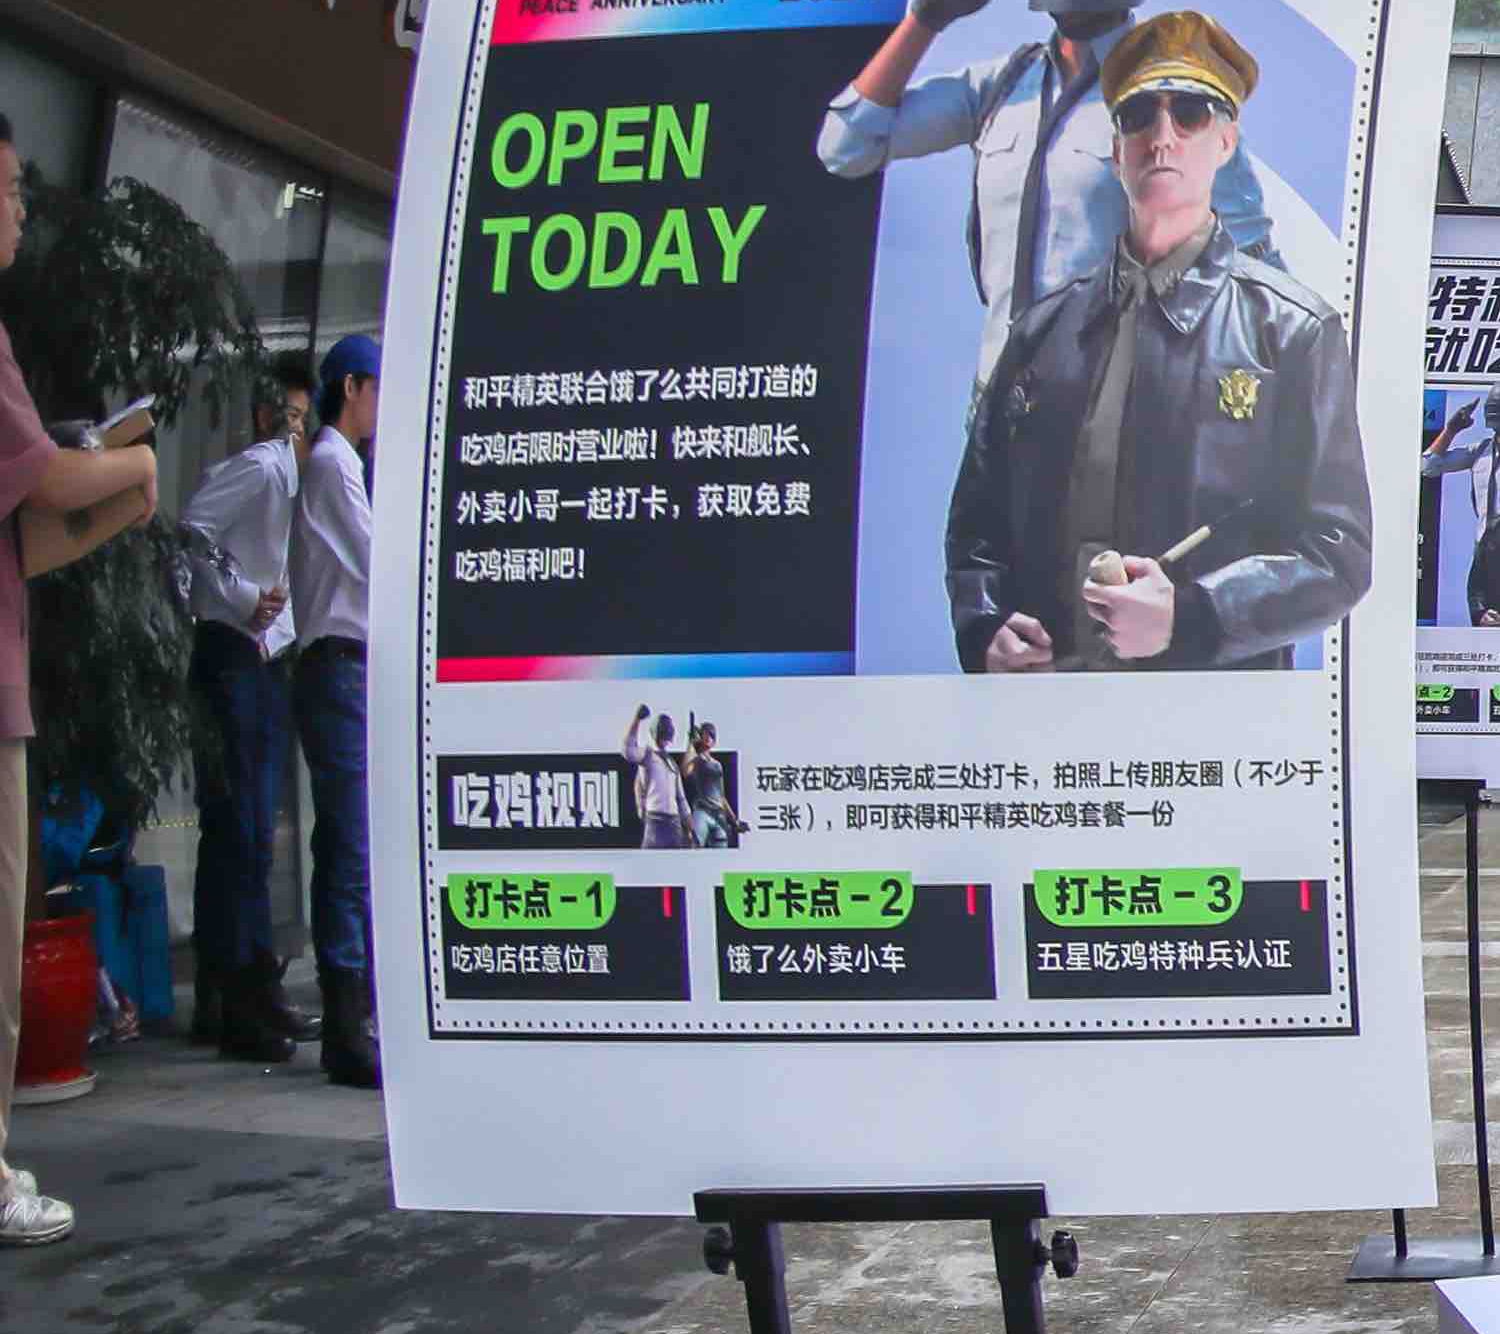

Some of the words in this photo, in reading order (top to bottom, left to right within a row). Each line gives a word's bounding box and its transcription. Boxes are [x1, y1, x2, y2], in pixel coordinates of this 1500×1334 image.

[490, 102, 710, 189] OPEN
[480, 204, 767, 294] TODAY
[463, 363, 818, 410] 和平精英联合饿了么共同打造的
[455, 481, 812, 526] 外卖小哥一起打卡，获取免费
[452, 769, 620, 829] 吃鸡规则
[451, 943, 611, 975] 吃鸡店任意位置
[726, 943, 906, 976] 饿了么外卖小车
[1036, 938, 1293, 973] 五星吃鸡特种兵认证
